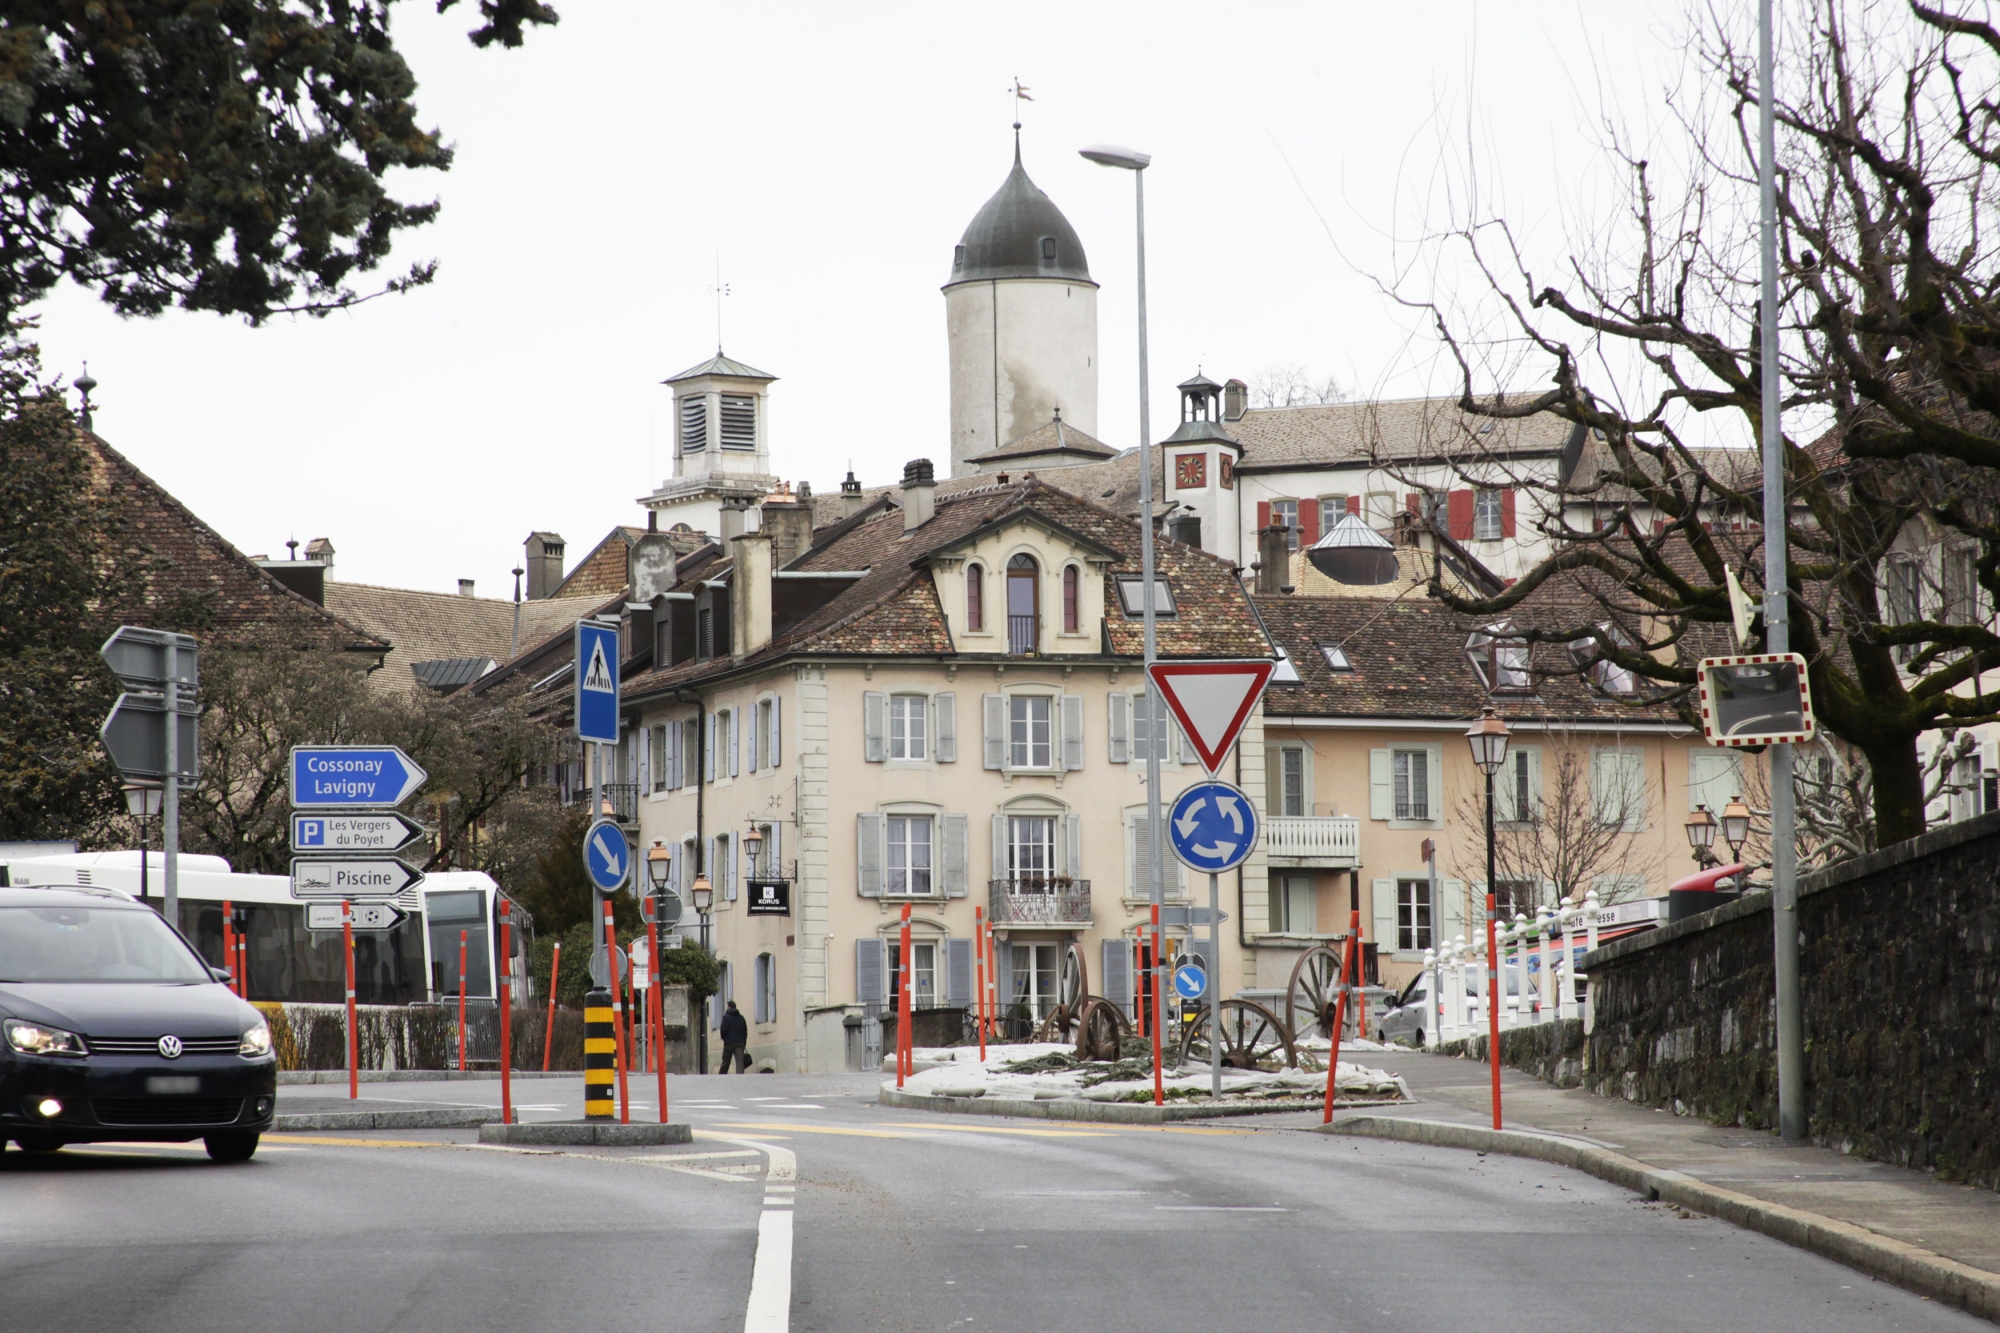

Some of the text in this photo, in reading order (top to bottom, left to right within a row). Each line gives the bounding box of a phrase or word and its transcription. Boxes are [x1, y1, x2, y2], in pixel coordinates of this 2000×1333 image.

[308, 758, 383, 776] Cossonay
[315, 779, 376, 798] Lavigny
[304, 822, 318, 844] P
[329, 820, 391, 833] Les Vergers
[336, 834, 384, 849] du Poyet
[337, 871, 392, 886] Piscine
